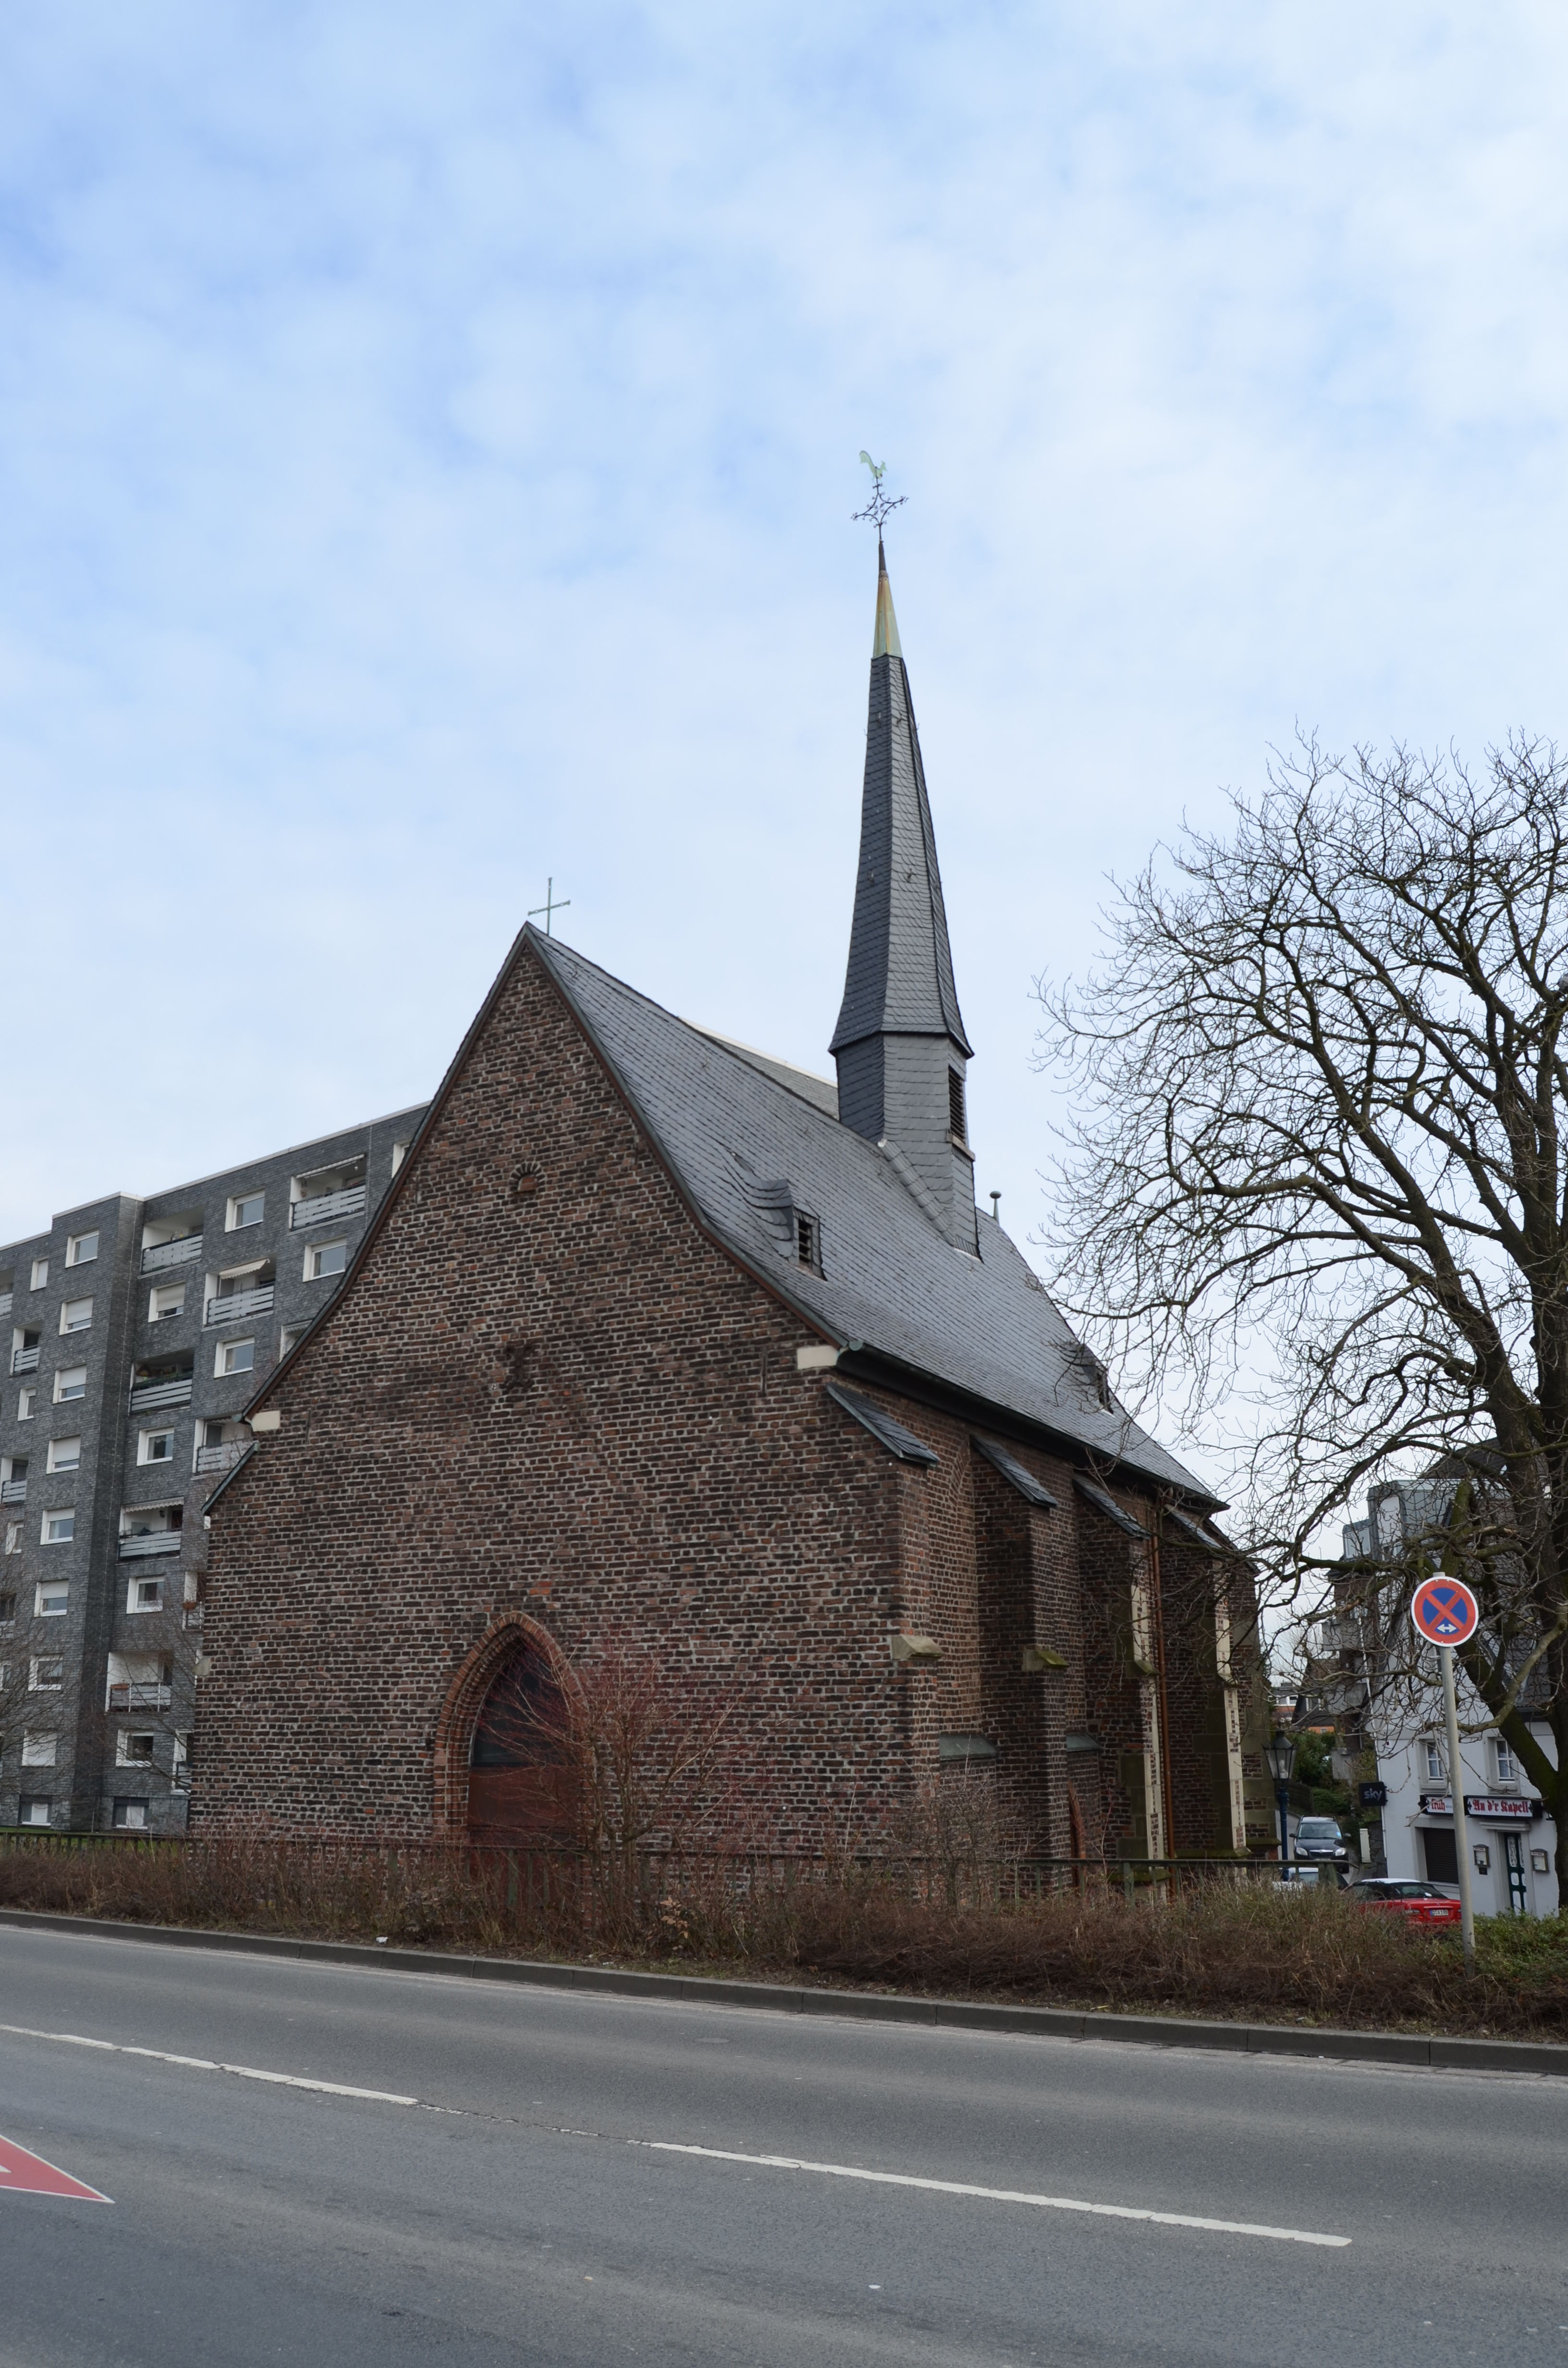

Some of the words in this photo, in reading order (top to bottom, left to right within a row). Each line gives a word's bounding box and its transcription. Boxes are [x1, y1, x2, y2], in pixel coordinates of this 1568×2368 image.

[1364, 1788, 1382, 1801] sky
[1472, 1799, 1485, 1811] An
[1501, 1800, 1529, 1816] Kapell
